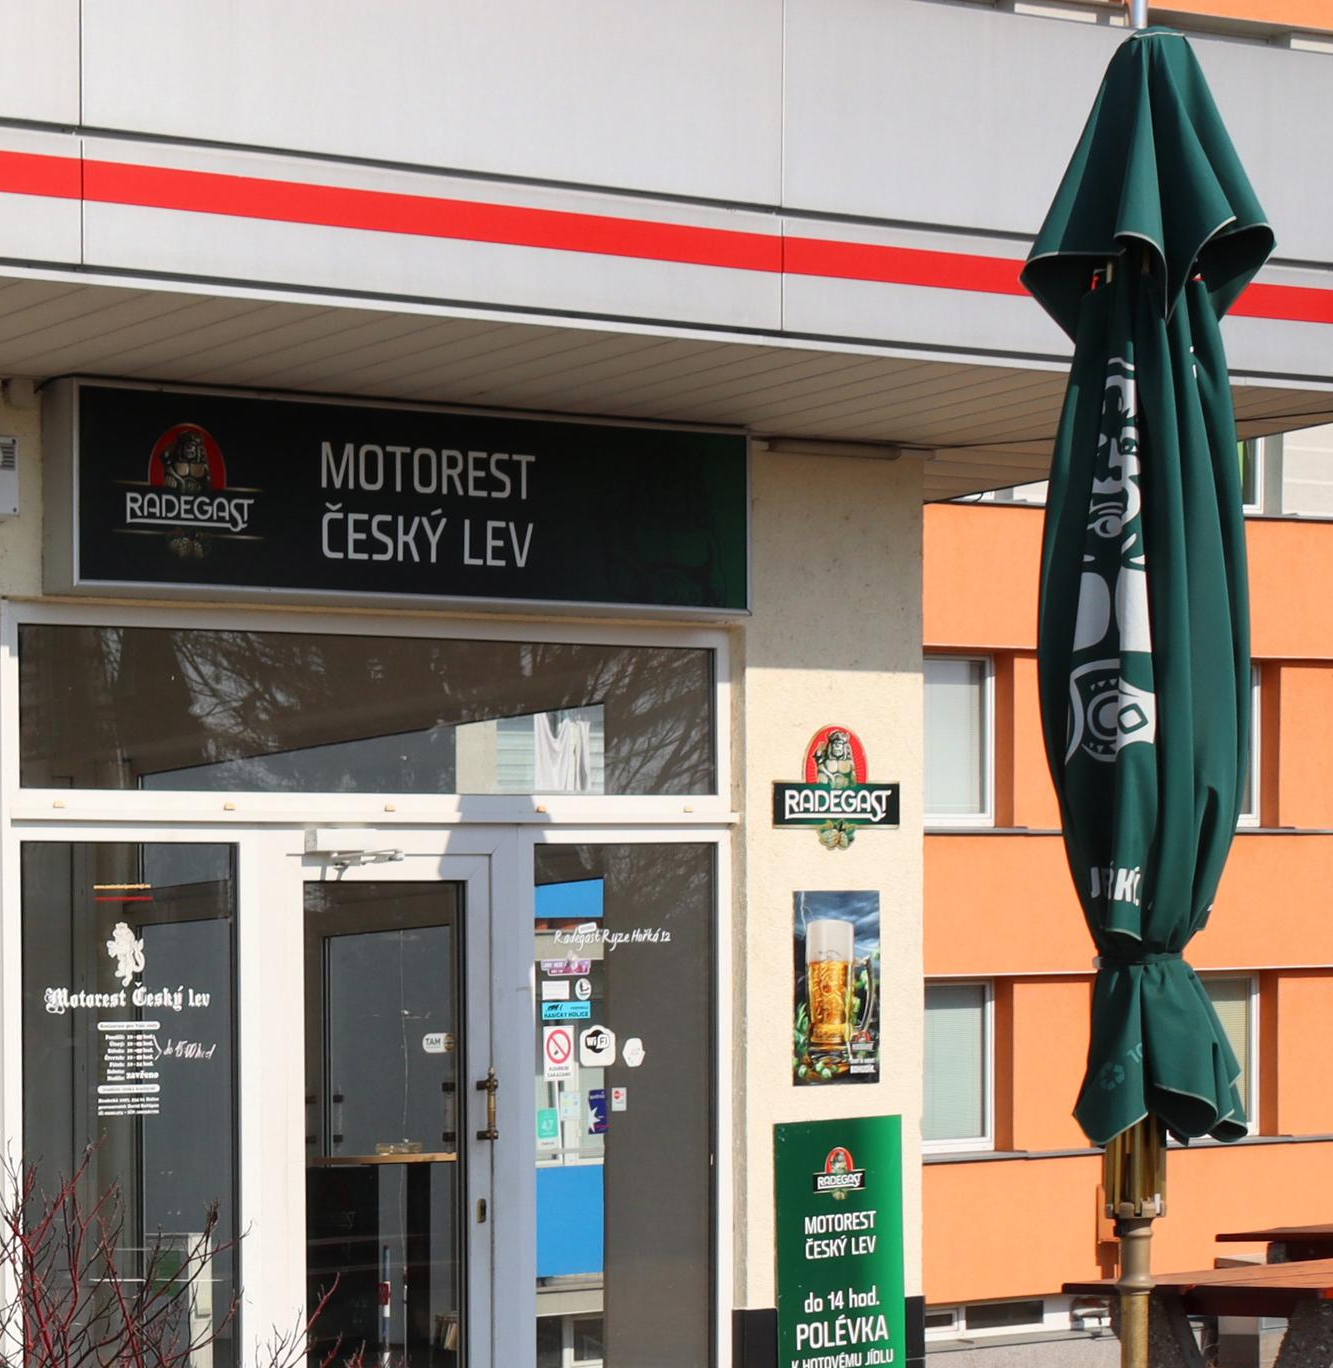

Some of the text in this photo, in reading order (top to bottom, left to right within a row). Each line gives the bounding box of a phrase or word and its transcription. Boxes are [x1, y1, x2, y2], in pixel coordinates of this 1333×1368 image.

[321, 441, 535, 500] MOTOREST
[126, 492, 254, 532] RADEGAST
[322, 502, 533, 567] ČESKÝ LEV
[785, 790, 892, 822] RADEGAST
[44, 982, 210, 1015] Motorest Český lev
[817, 1173, 863, 1190] RADEGAST
[805, 1211, 876, 1234] MOTOREST
[805, 1235, 876, 1260] ČESKÝ LEV
[804, 1285, 880, 1313] do 14 hod.
[796, 1314, 889, 1351] POLÉVKA
[864, 1348, 894, 1366] JÍDLU
